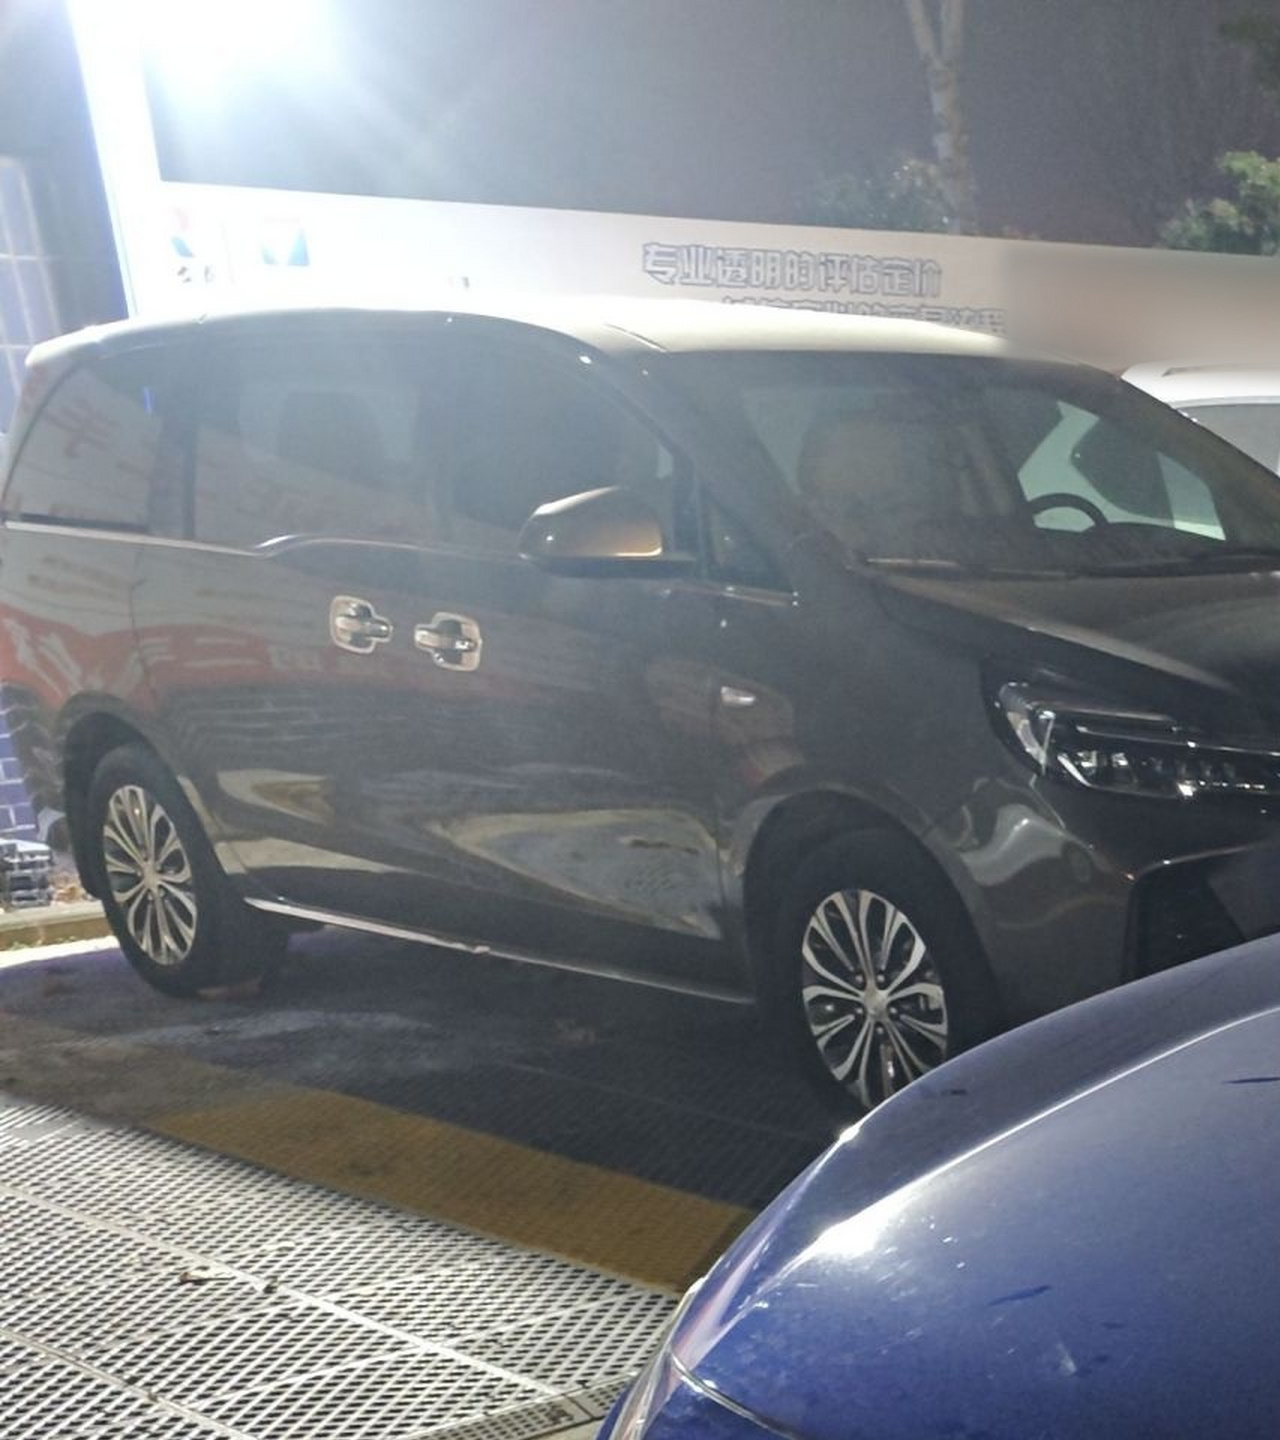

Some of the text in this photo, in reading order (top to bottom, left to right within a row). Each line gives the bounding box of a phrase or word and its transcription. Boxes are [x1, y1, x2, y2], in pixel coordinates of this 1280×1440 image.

[643, 243, 942, 297] 专业透明的评估定价
